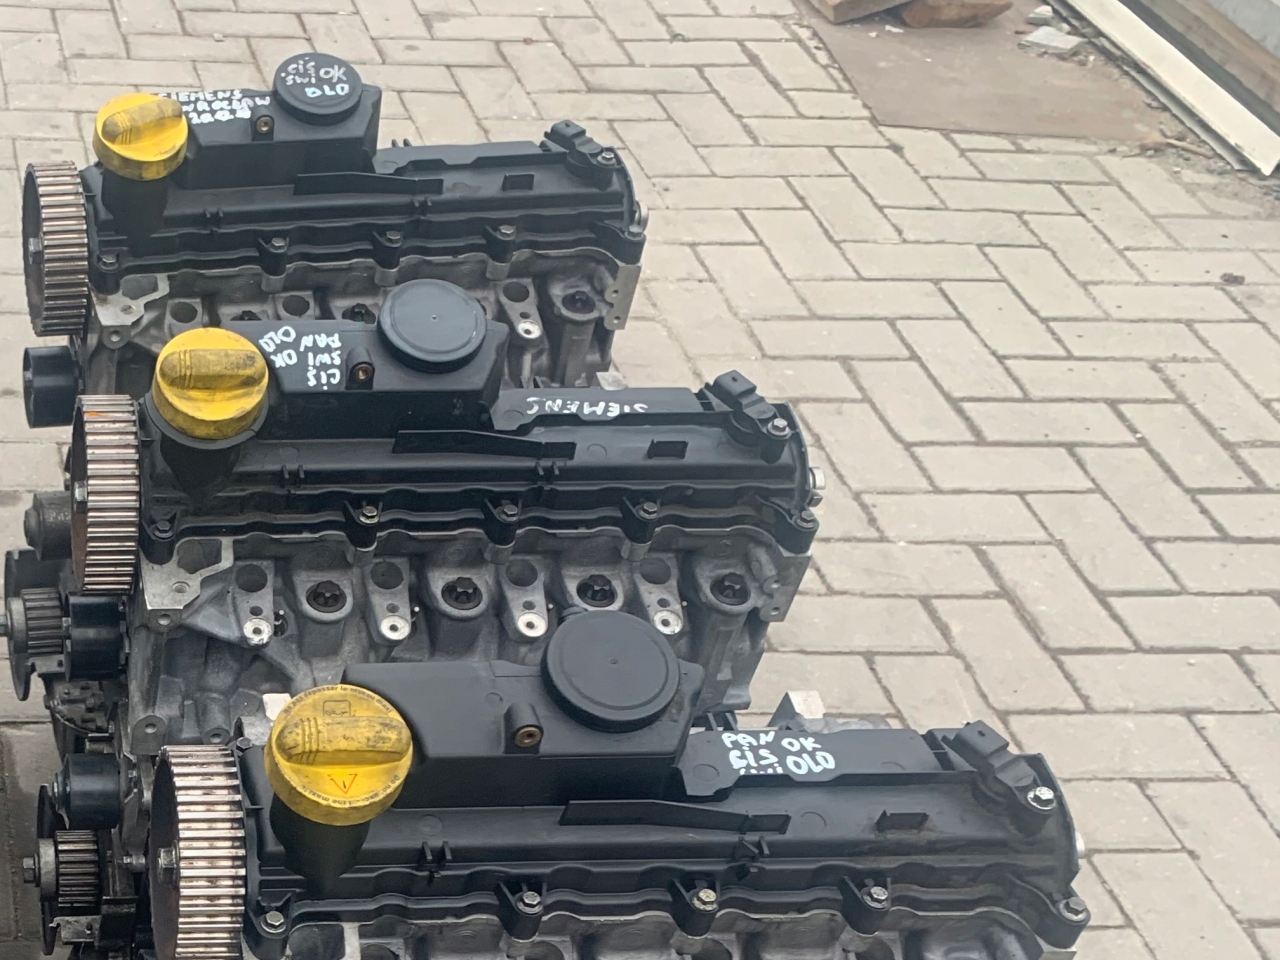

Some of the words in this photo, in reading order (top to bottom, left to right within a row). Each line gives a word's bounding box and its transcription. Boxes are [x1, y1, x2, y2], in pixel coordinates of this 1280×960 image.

[320, 65, 347, 82] OK
[300, 333, 342, 352] PAN
[270, 349, 298, 368] OK
[721, 731, 775, 748] PAN
[781, 737, 822, 752] OK
[786, 751, 835, 775] OLD
